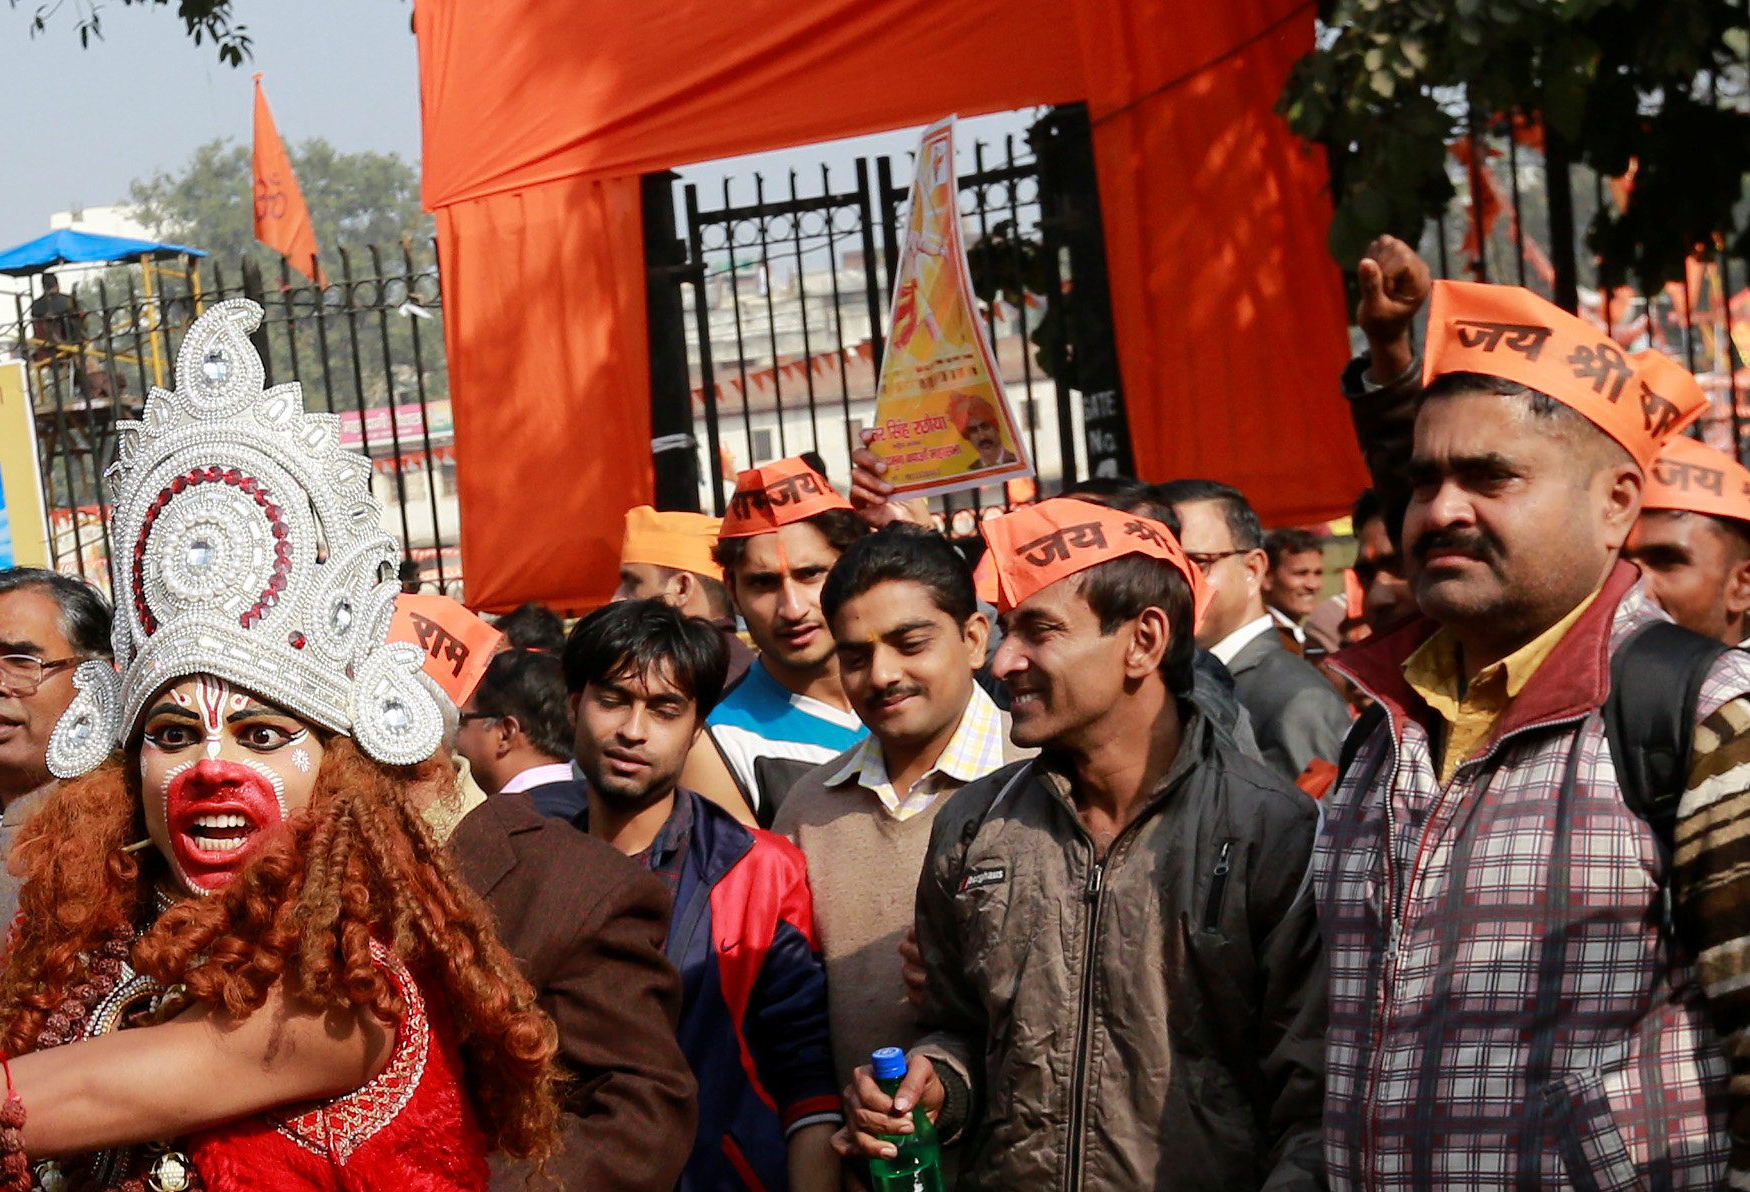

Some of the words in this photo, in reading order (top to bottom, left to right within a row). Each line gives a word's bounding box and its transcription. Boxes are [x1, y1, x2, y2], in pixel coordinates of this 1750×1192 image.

[1453, 320, 1554, 362] जय
[1567, 342, 1633, 403] श्री
[765, 472, 824, 506] जय
[1651, 458, 1724, 497] जय
[1016, 521, 1109, 567] जय
[409, 611, 471, 679] राम
